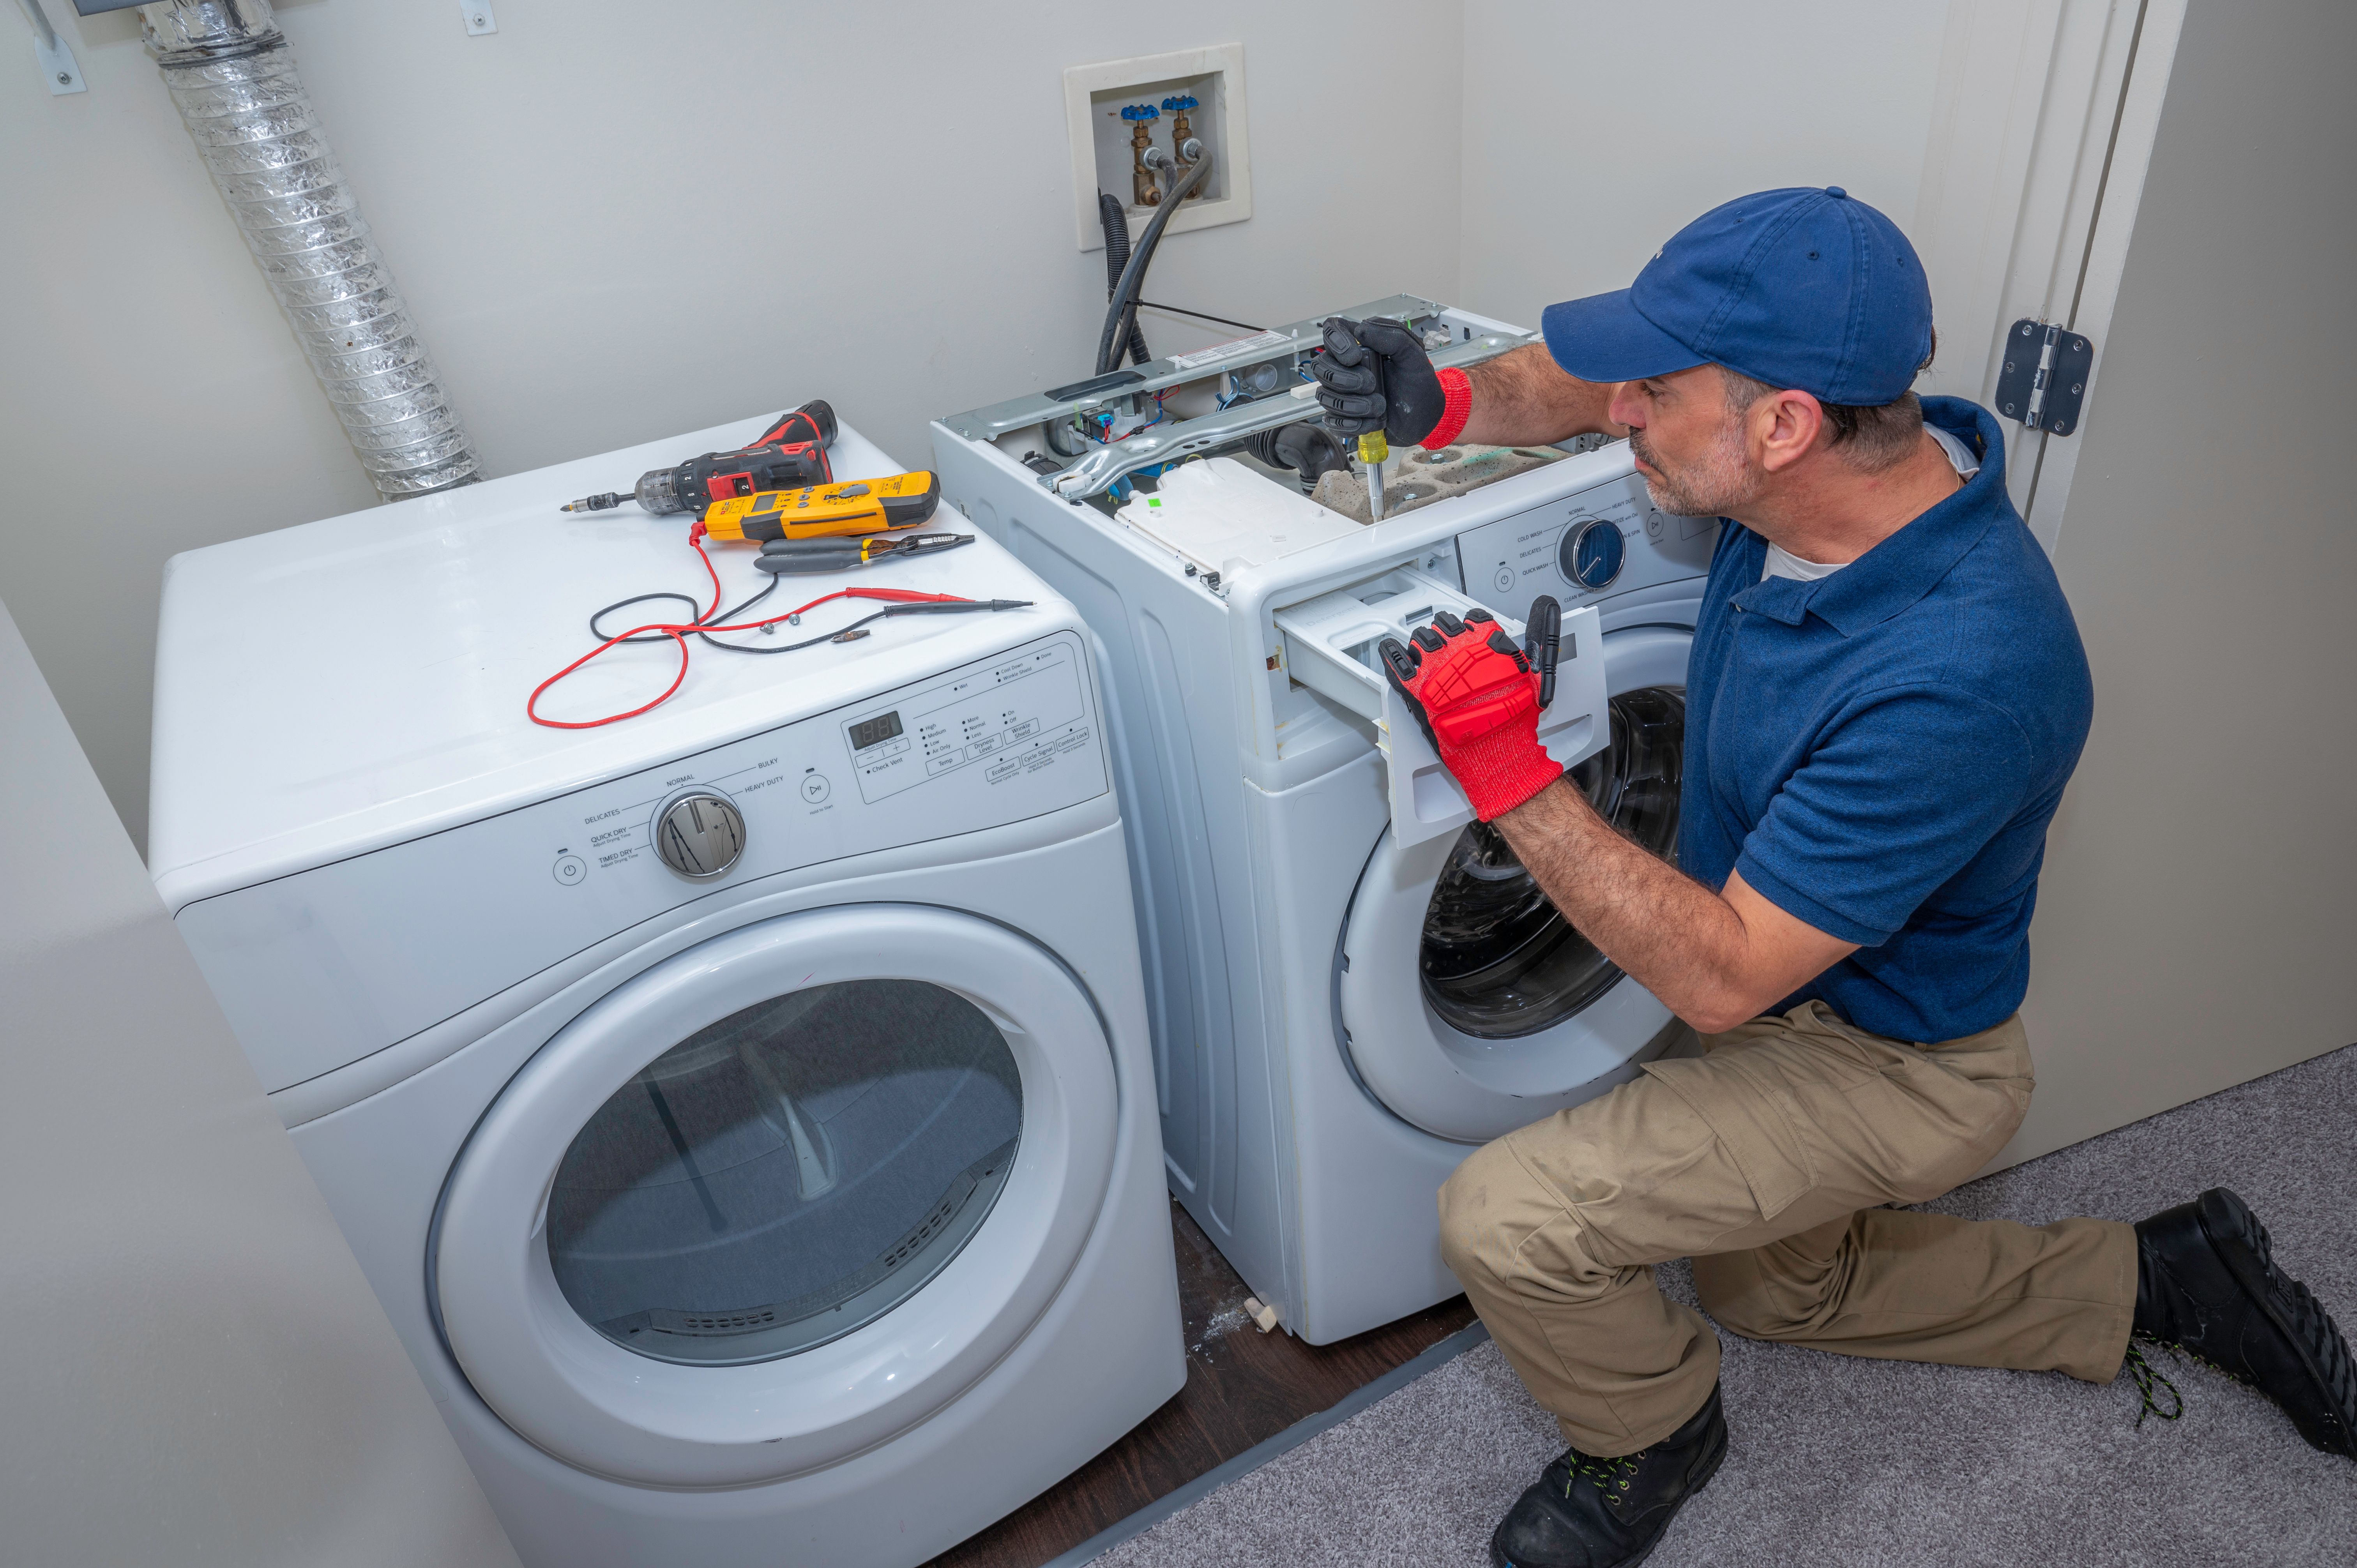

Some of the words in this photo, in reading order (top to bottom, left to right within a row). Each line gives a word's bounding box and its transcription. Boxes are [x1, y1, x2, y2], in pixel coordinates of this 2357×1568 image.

[1569, 507, 1586, 516] NORMAL
[1520, 547, 1541, 558] DELICATES
[1564, 594, 1577, 603] CLEAN
[1578, 588, 1594, 597] WASHER
[1003, 672, 1018, 680] Wrinkle
[970, 722, 986, 731] Normal
[1012, 723, 1030, 734] Wrinkle
[928, 729, 946, 738] Medium
[1014, 729, 1030, 739] Shield
[1058, 736, 1076, 747] Control
[1076, 731, 1087, 740] Lock
[974, 738, 995, 750] Dryness
[979, 744, 992, 754] Level
[1024, 752, 1037, 763] Cycle
[1038, 746, 1053, 758] Signal
[758, 758, 778, 768] BULKY
[872, 763, 889, 772] Check
[890, 758, 903, 766] Vent
[938, 758, 952, 766] Temp
[992, 763, 1015, 776] EcoBoost
[667, 774, 694, 787] NORMAL
[745, 782, 765, 793] HEAVY
[767, 776, 783, 786] DUTY
[585, 809, 620, 824] DELICATES
[591, 832, 613, 843] QUICK
[613, 827, 627, 835] DRY
[599, 853, 618, 863] TIMED
[620, 848, 633, 856] DRY
